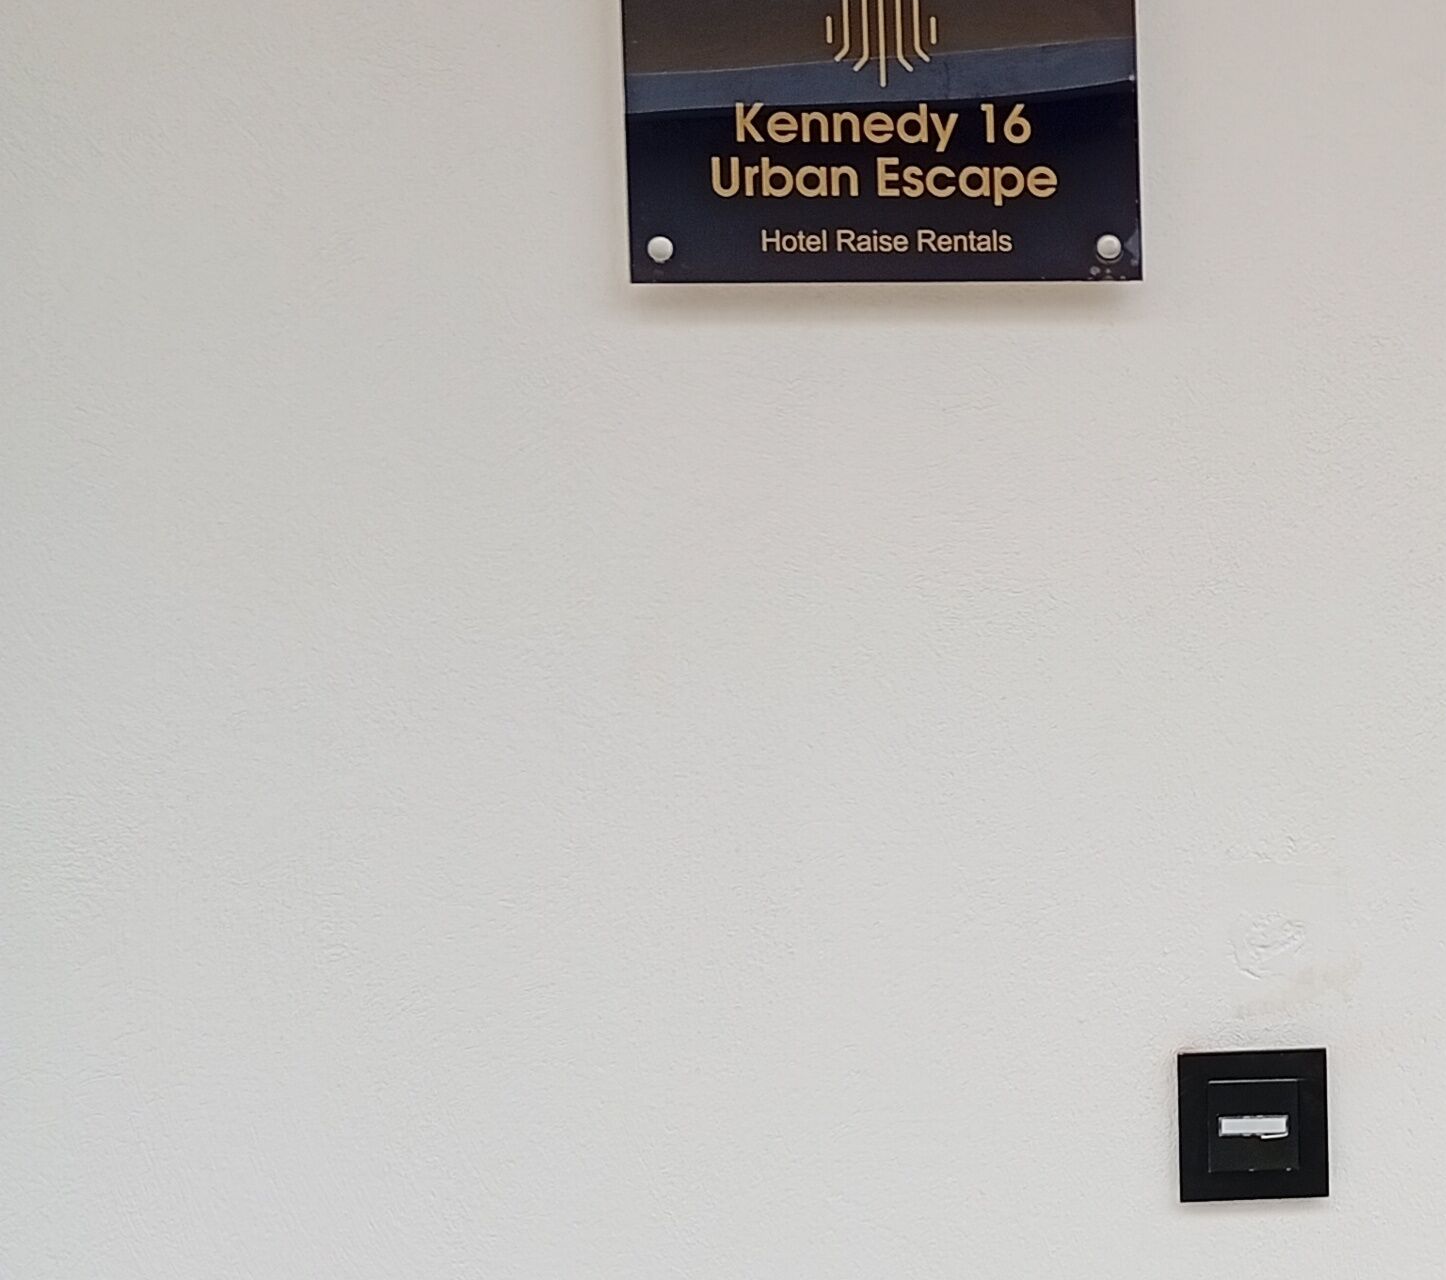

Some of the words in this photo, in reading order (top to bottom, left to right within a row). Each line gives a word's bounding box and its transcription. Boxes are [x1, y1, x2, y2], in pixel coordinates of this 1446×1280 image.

[735, 102, 959, 153] Kennedy
[980, 103, 1032, 144] 16
[711, 156, 859, 198] Urban
[876, 156, 1058, 207] Escape
[761, 229, 828, 252] Hotel
[836, 229, 909, 252] Raise
[917, 229, 1013, 252] Rentals
